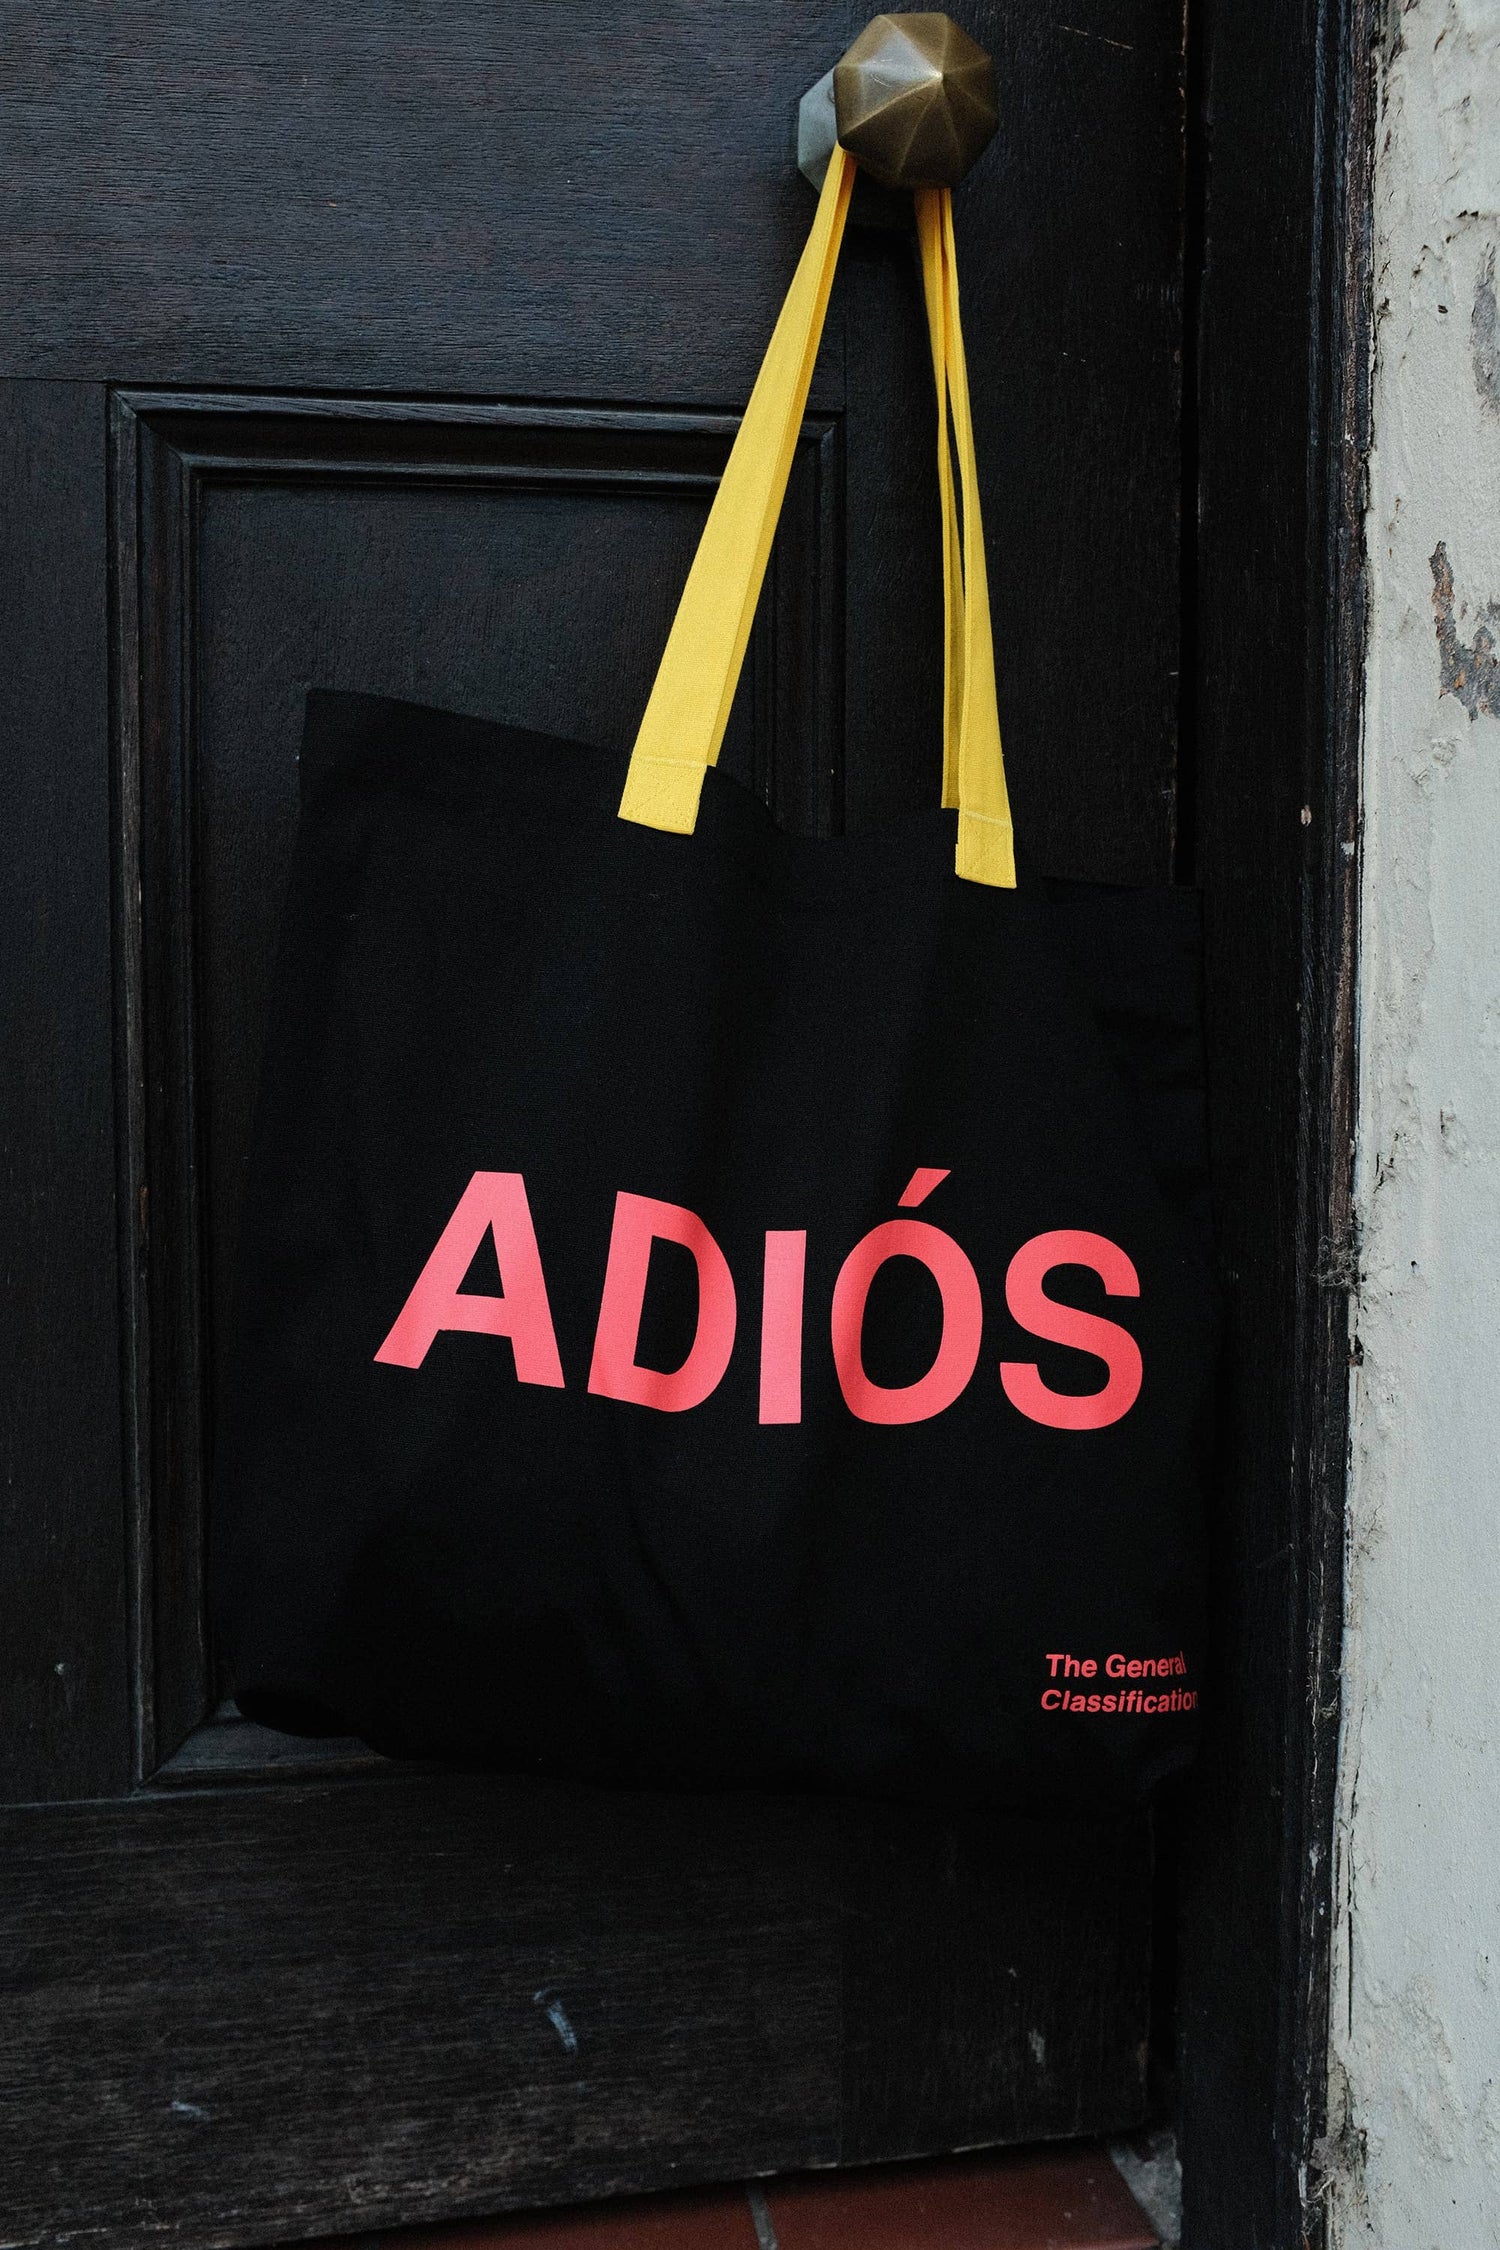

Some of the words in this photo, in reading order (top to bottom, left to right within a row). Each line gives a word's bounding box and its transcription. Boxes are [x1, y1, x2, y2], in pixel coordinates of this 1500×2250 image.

[373, 1168, 1144, 1431] ADIÓS
[1045, 1653, 1098, 1678] The
[1105, 1650, 1187, 1678] General
[1040, 1688, 1199, 1714] Classification
